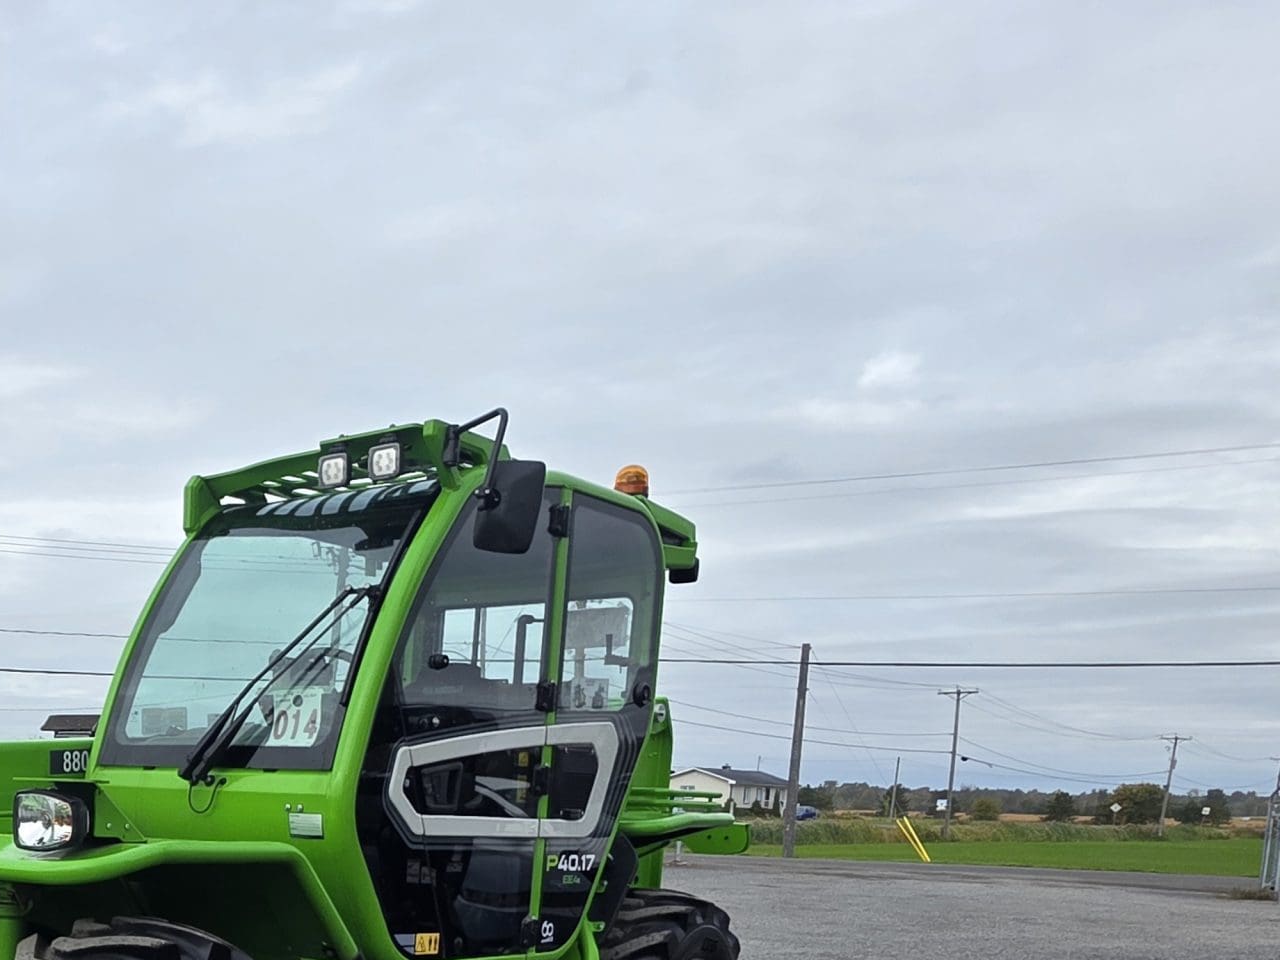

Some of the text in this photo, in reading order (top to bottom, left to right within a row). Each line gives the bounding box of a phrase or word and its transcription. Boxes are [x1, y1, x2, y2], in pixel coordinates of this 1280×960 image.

[273, 709, 318, 740] 014
[63, 751, 89, 772] 880
[546, 854, 595, 872] P40.17
